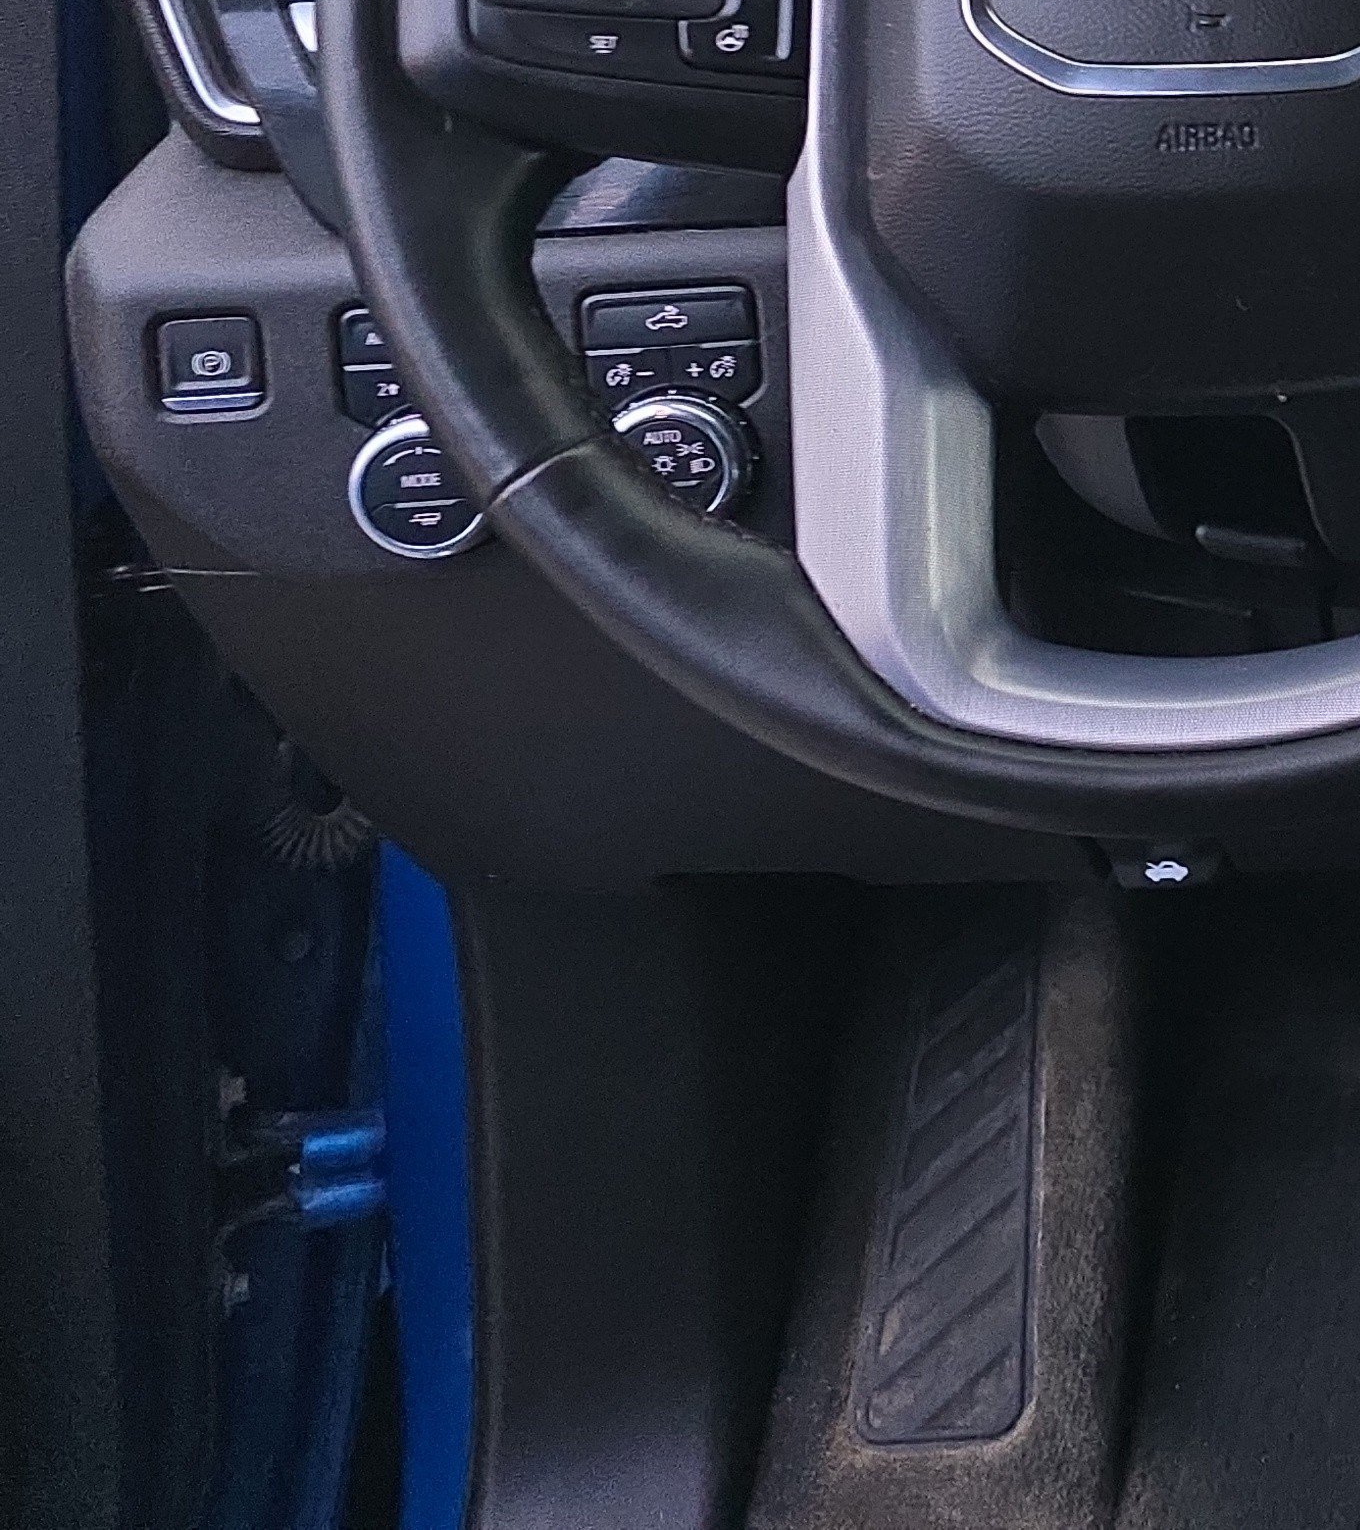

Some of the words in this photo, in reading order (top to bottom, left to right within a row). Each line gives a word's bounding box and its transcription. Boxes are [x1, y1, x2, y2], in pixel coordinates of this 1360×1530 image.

[1155, 119, 1260, 154] AIRBAG
[643, 430, 682, 445] AUTO
[400, 473, 442, 488] MODE
